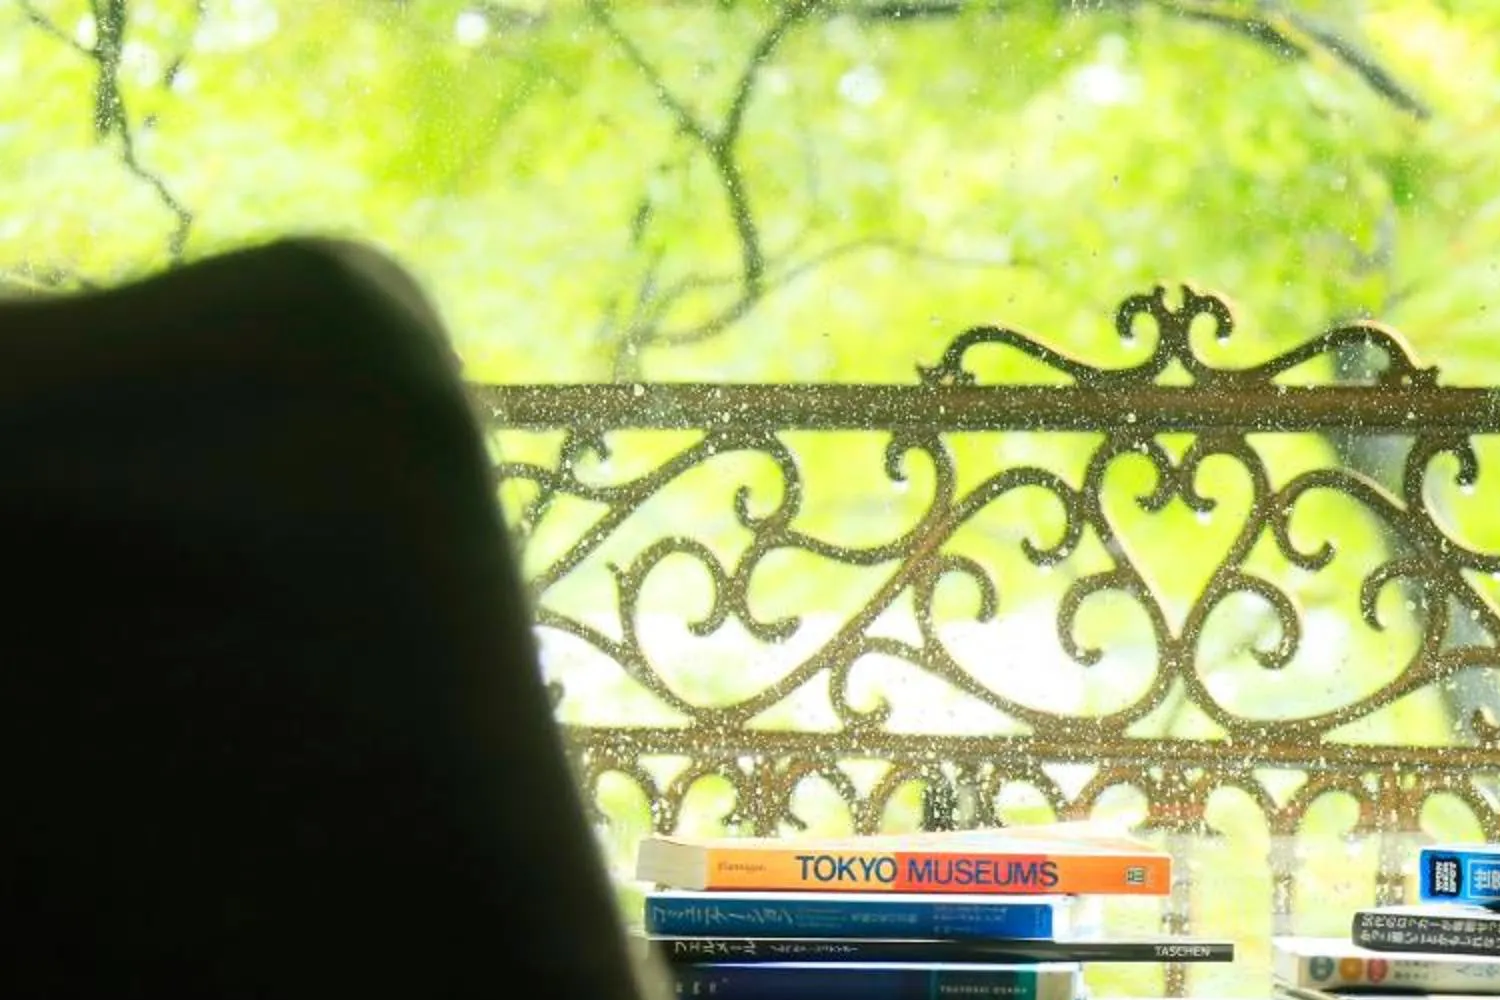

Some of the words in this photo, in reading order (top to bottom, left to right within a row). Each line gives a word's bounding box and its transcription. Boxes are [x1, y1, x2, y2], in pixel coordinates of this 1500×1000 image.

[795, 854, 899, 883] TOKYO
[906, 857, 1059, 887] MUSEUMS
[1154, 945, 1212, 957] TASCHEN
